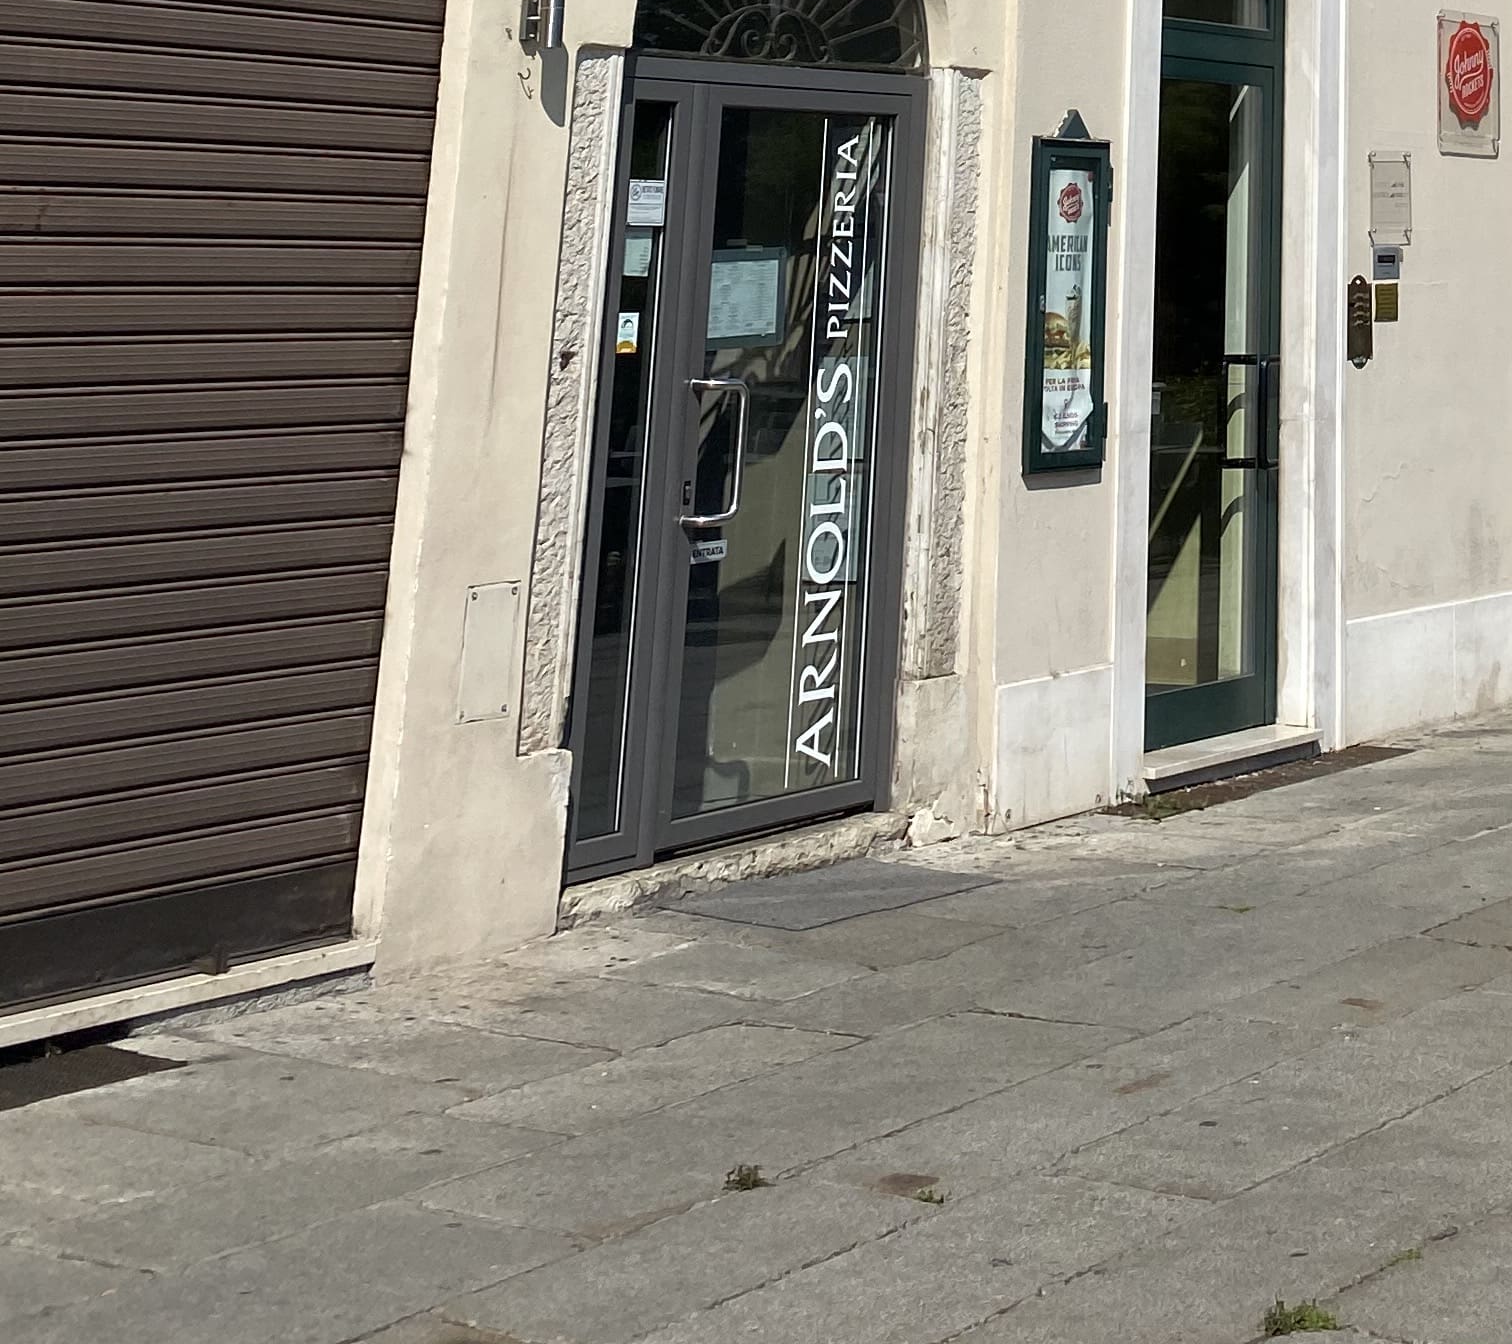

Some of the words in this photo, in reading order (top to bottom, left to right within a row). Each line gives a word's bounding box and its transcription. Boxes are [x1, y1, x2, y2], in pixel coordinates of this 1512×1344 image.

[1453, 49, 1483, 91] Johnny
[1055, 254, 1081, 272] ICONS
[795, 363, 853, 768] ARNOLD'S
[826, 134, 860, 340] PIZZERIA
